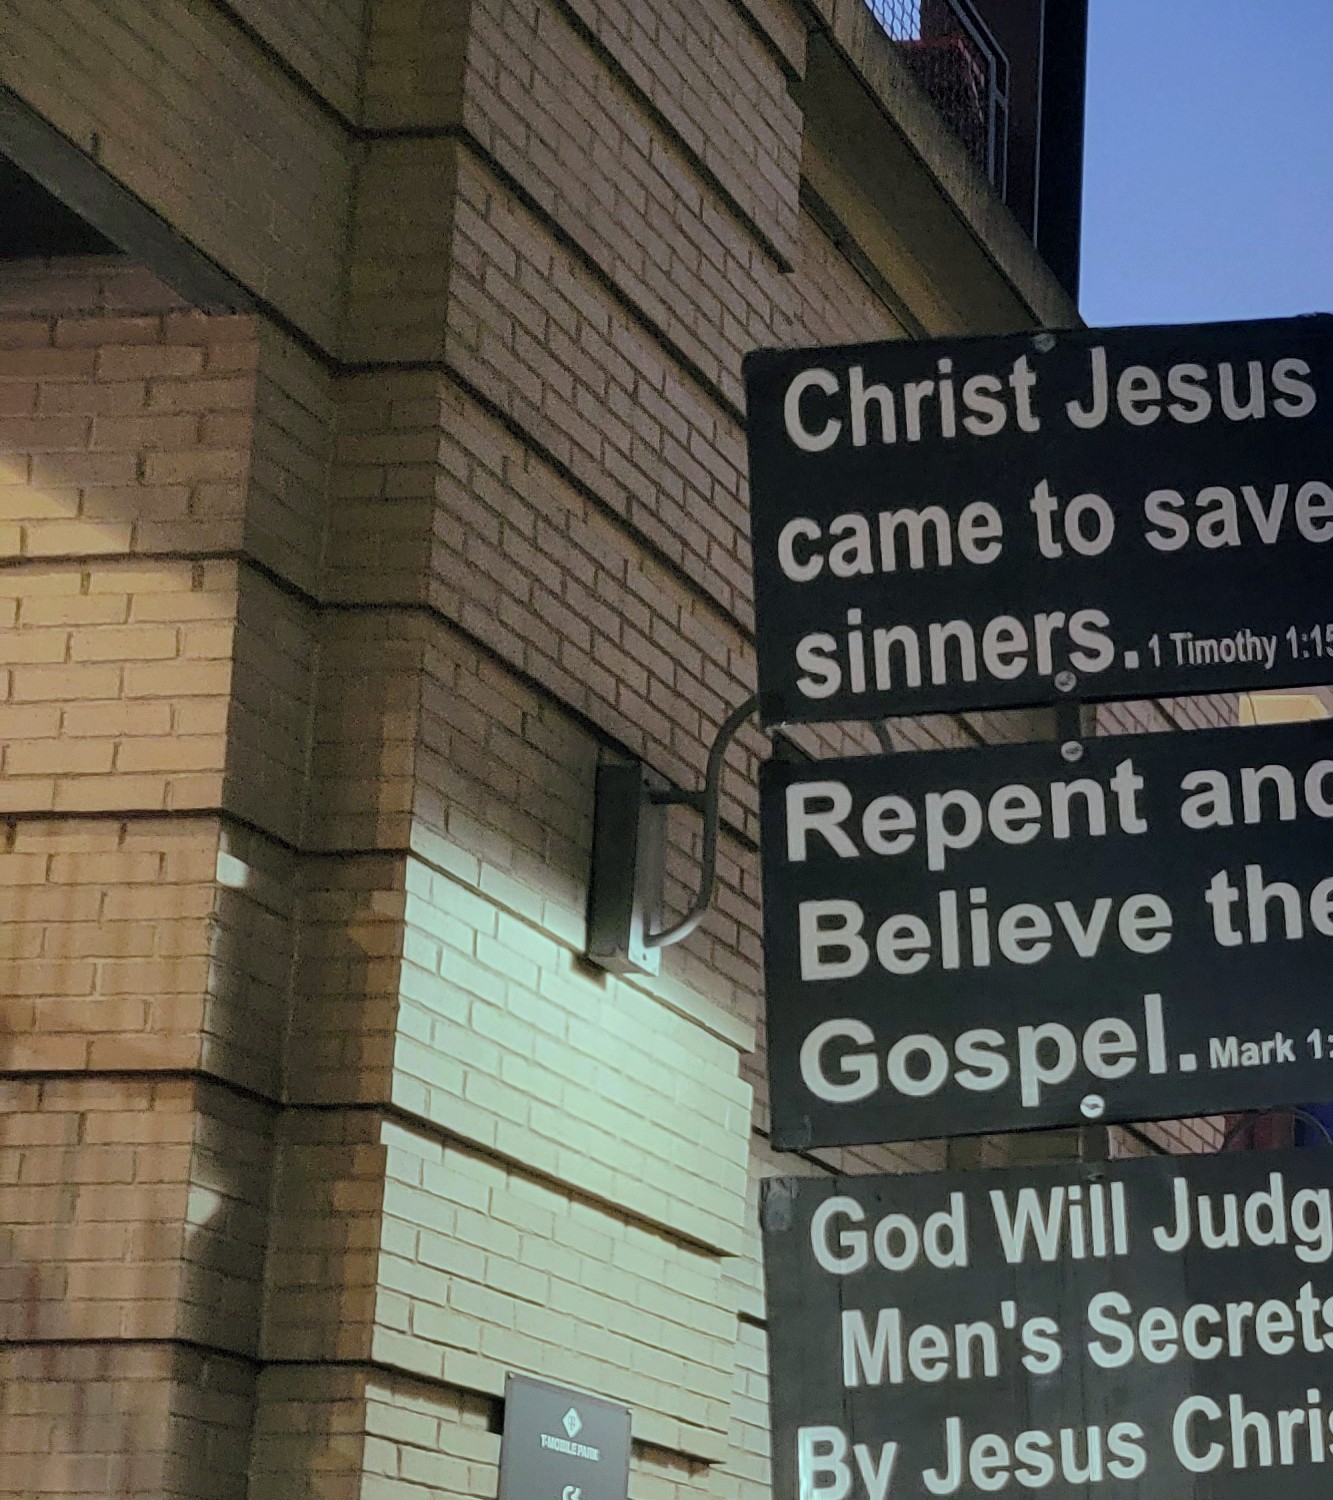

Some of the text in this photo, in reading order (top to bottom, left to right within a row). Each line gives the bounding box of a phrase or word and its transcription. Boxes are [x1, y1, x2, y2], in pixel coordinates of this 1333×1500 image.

[783, 346, 1316, 452] Christ Jesus
[777, 500, 1003, 582] came
[1030, 478, 1115, 559] to
[796, 607, 1140, 699] sinners.
[1149, 636, 1160, 668] 1
[1169, 631, 1276, 670] Timothy
[785, 758, 1146, 871] Repent
[798, 887, 1173, 980] Believe
[801, 994, 1196, 1107] Gospel.
[1209, 1028, 1296, 1070] Mark
[810, 1192, 968, 1275] God
[990, 1181, 1128, 1264] Will
[841, 1300, 1062, 1387] Men's
[923, 1416, 1146, 1495] Jesus
